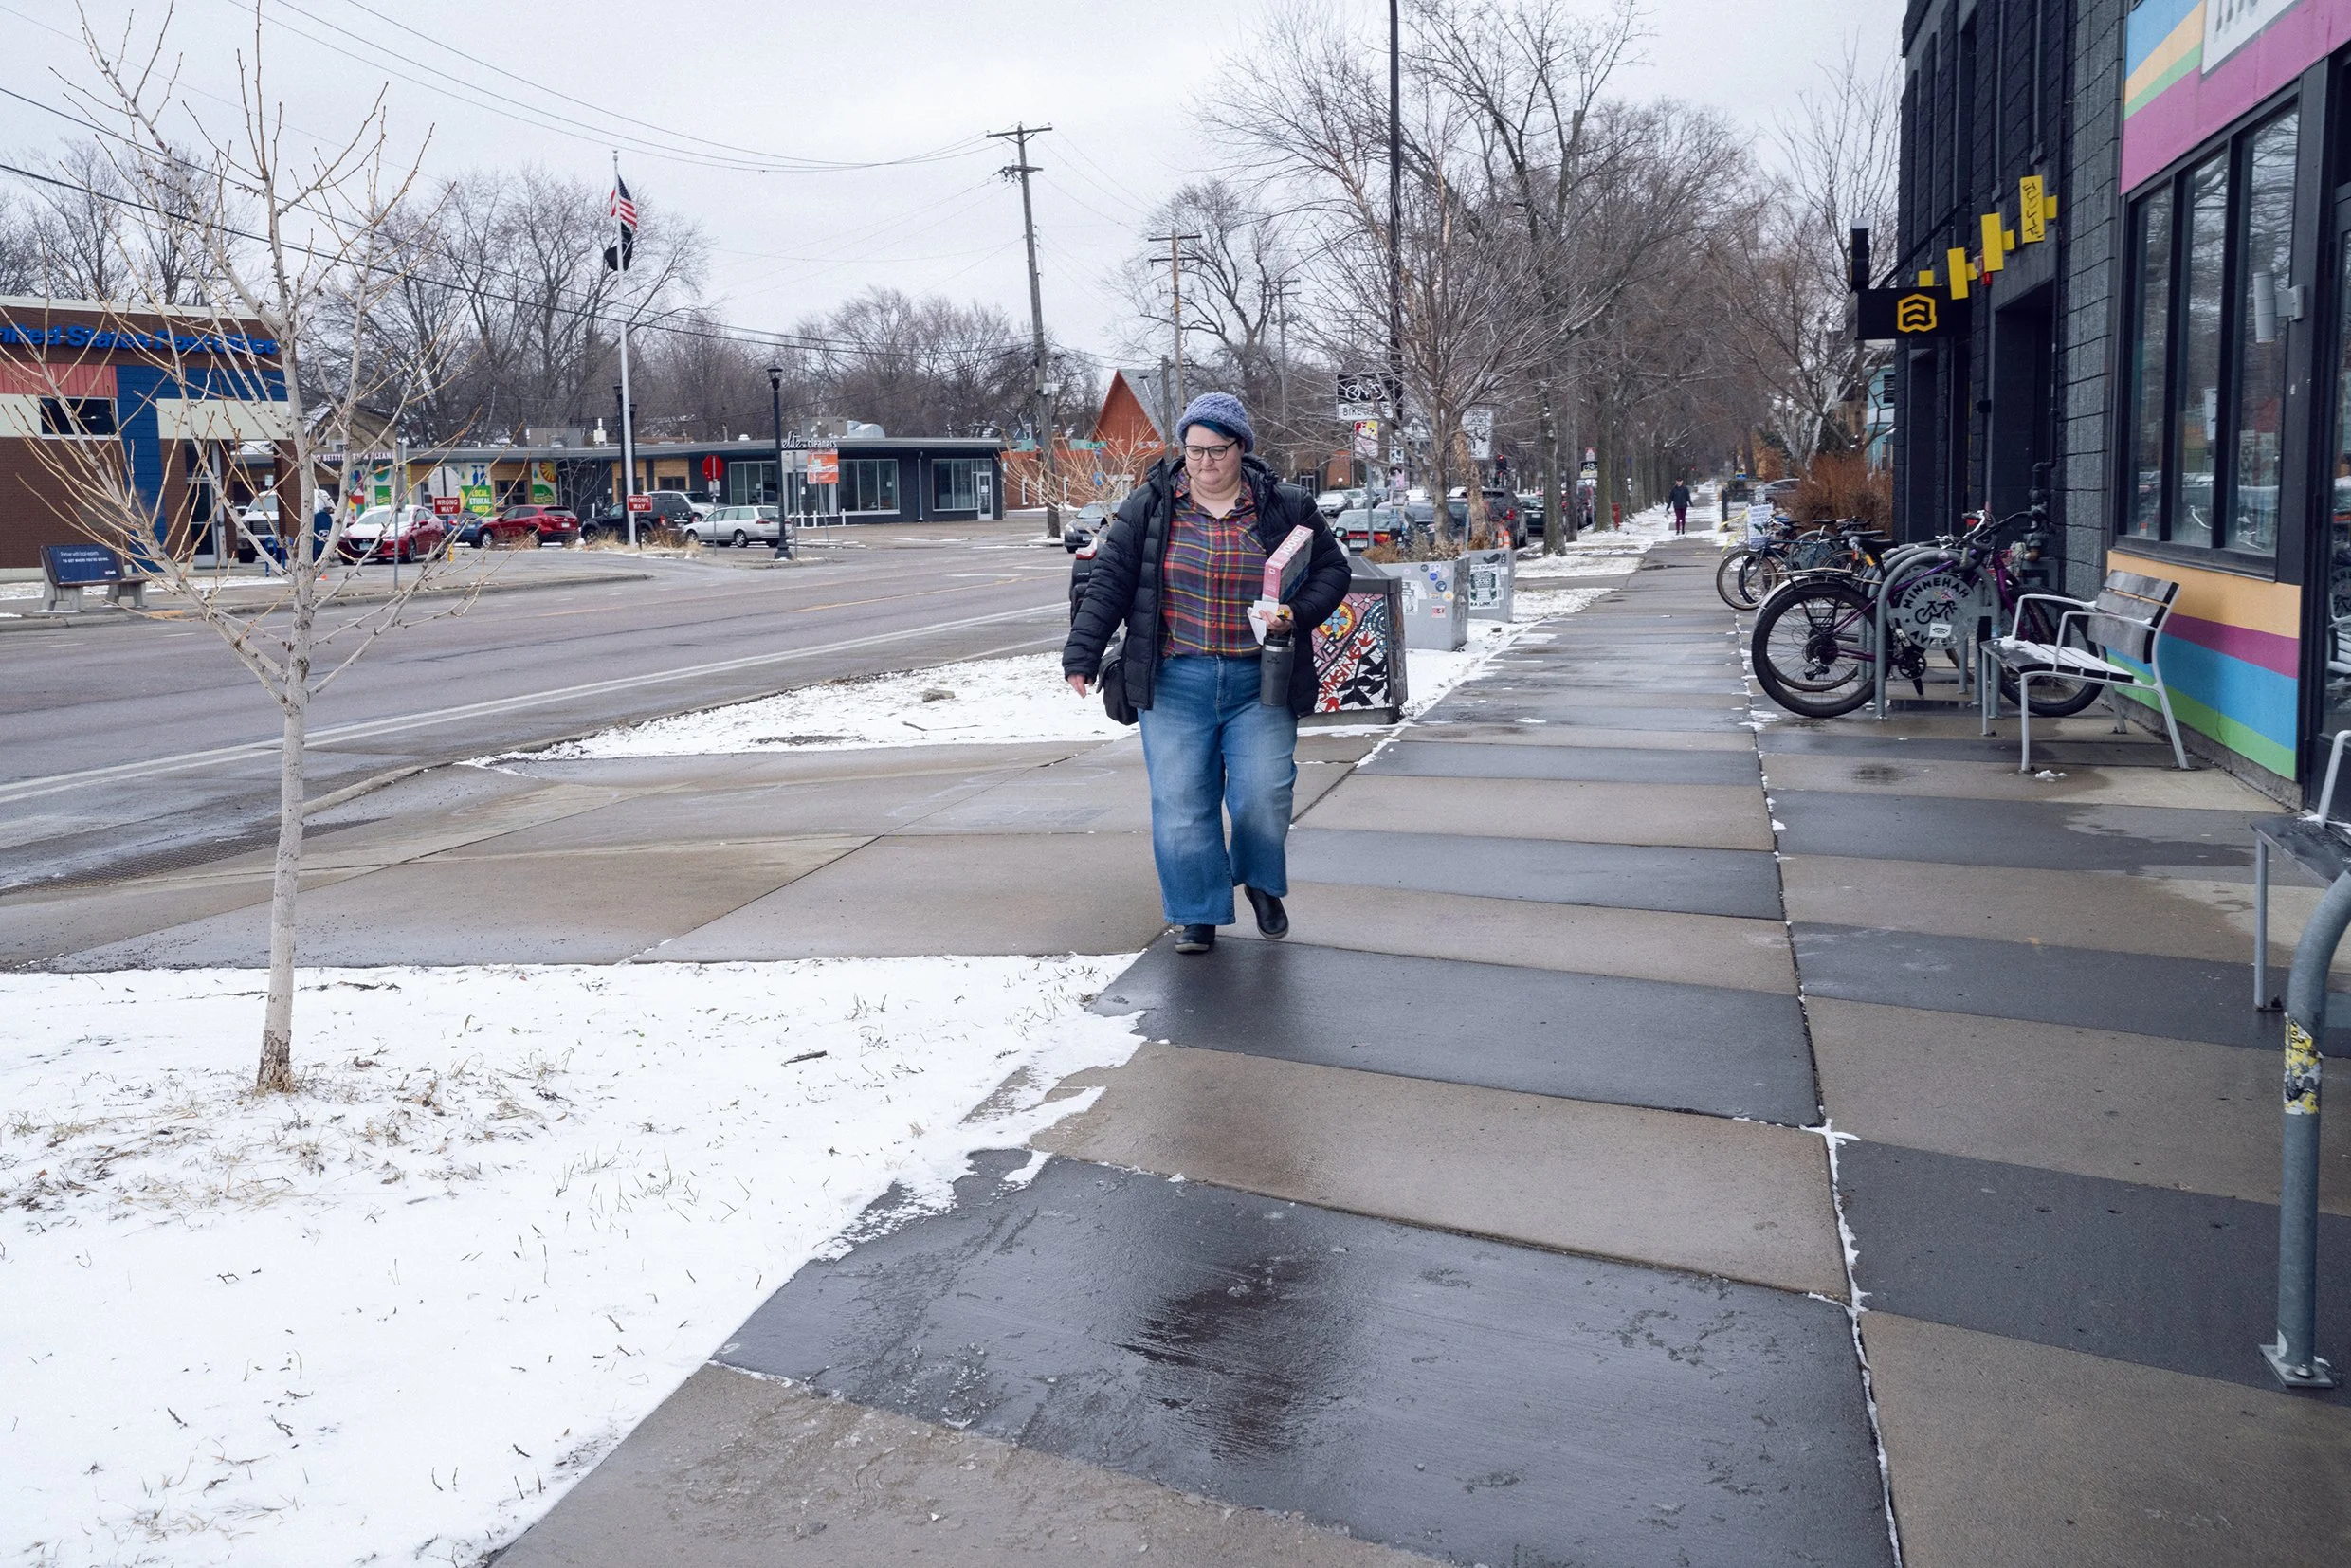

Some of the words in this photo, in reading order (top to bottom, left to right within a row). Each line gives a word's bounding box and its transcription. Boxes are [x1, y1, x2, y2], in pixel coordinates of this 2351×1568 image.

[0, 323, 62, 345] nited
[65, 325, 150, 348] States
[154, 330, 210, 352] Post
[1342, 407, 1361, 416] BIKE
[782, 431, 806, 448] elite
[807, 438, 837, 448] cleaners
[1903, 576, 1970, 610] MINNEHAH
